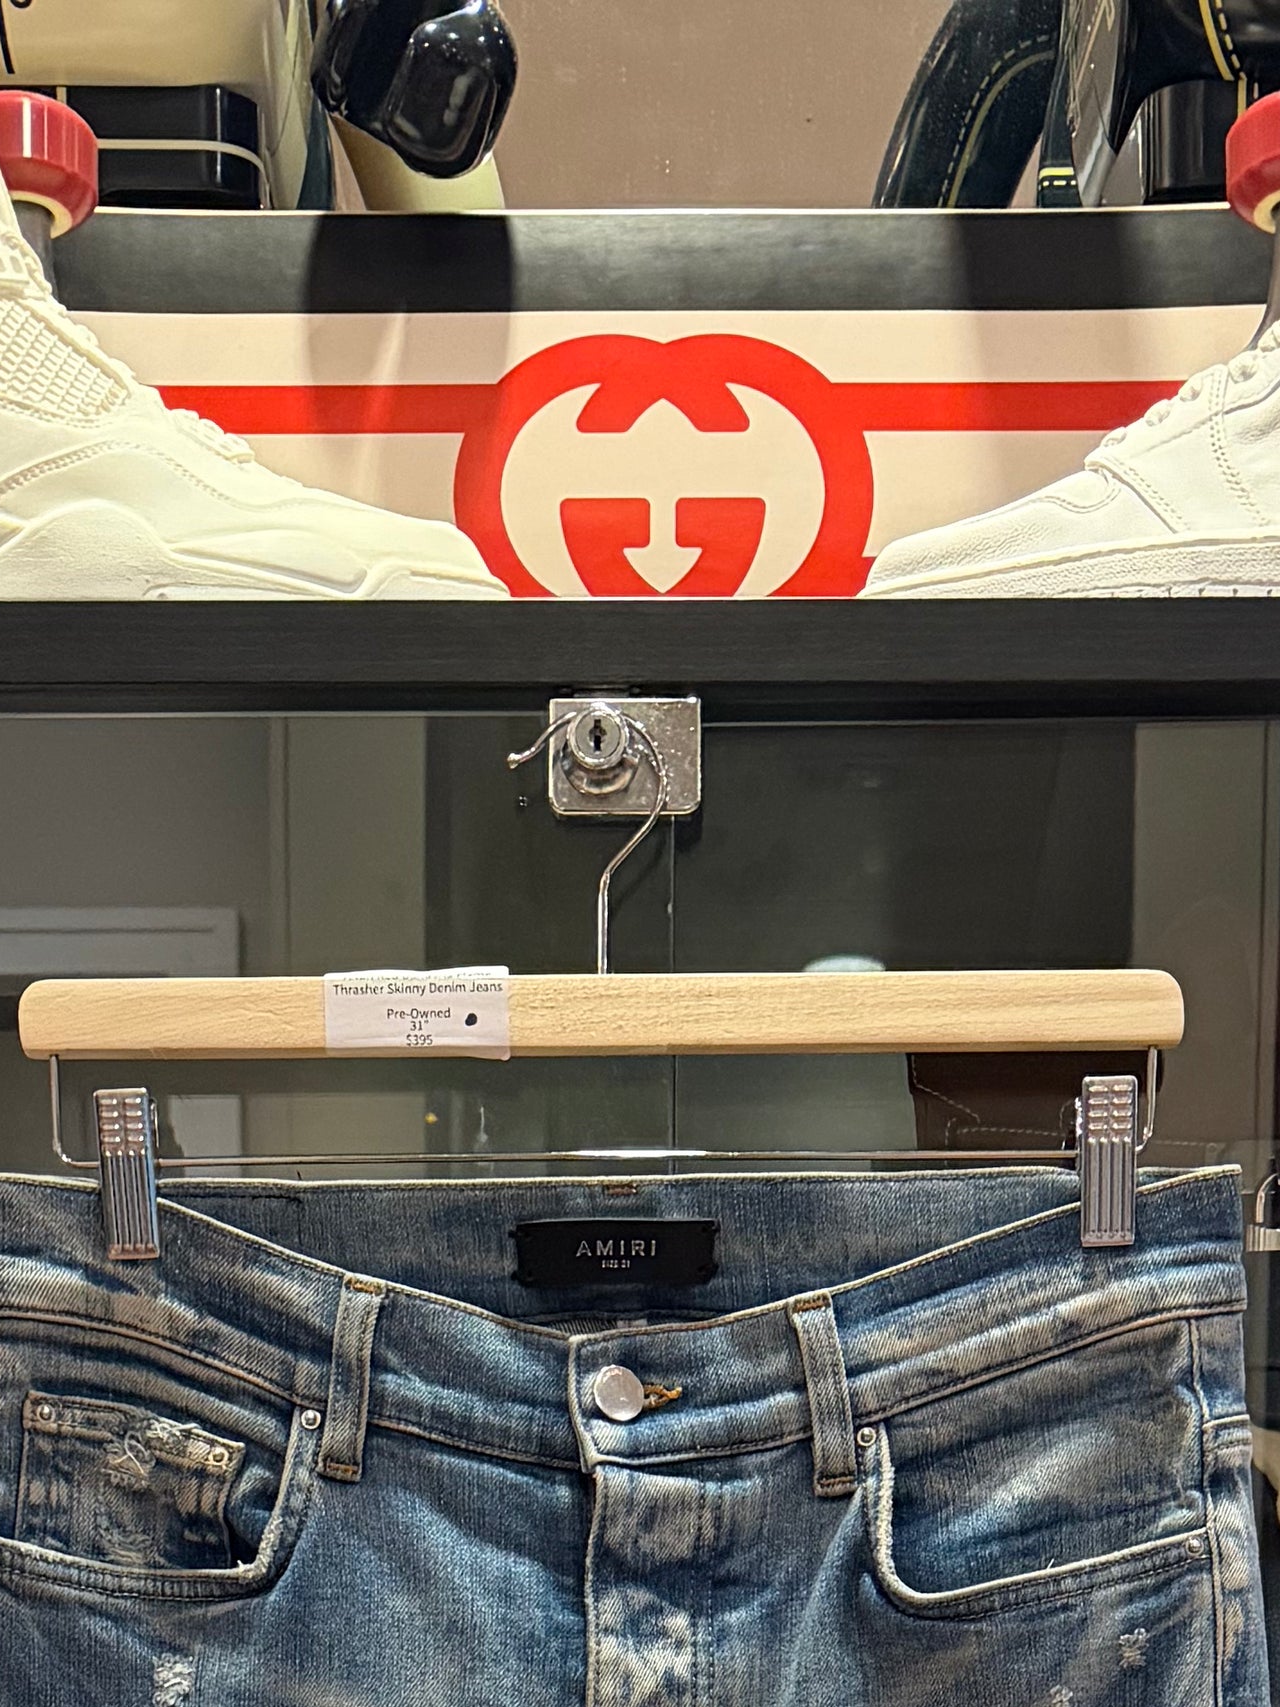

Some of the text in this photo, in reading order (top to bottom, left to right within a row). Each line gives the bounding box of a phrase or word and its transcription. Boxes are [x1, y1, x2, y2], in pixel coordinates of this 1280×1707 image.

[333, 981, 503, 997] Thrasher Skinny Denim Jeans
[386, 1007, 451, 1019] Pre-Owned
[406, 1034, 433, 1046] $395
[575, 1239, 657, 1257] AMIRI
